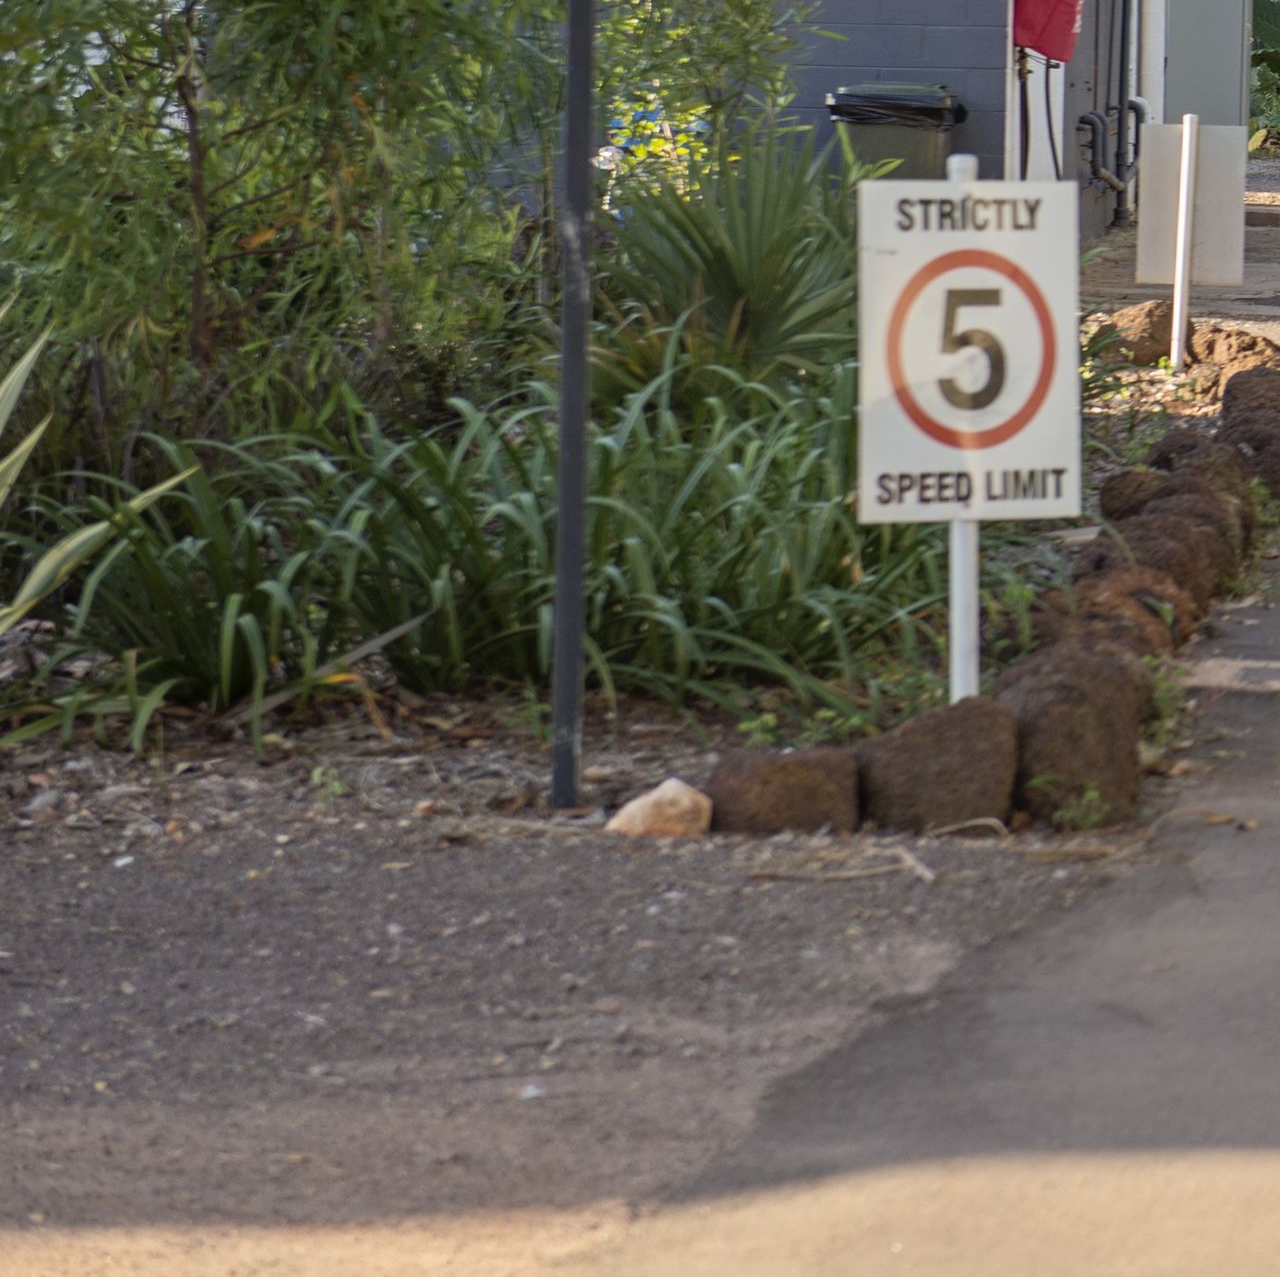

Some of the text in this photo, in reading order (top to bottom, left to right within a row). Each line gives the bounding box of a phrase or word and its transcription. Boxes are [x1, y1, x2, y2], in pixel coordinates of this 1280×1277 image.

[897, 196, 1042, 232] STRICTLY
[937, 288, 1008, 410] 5
[876, 468, 1067, 506] SPEED LIMIT
